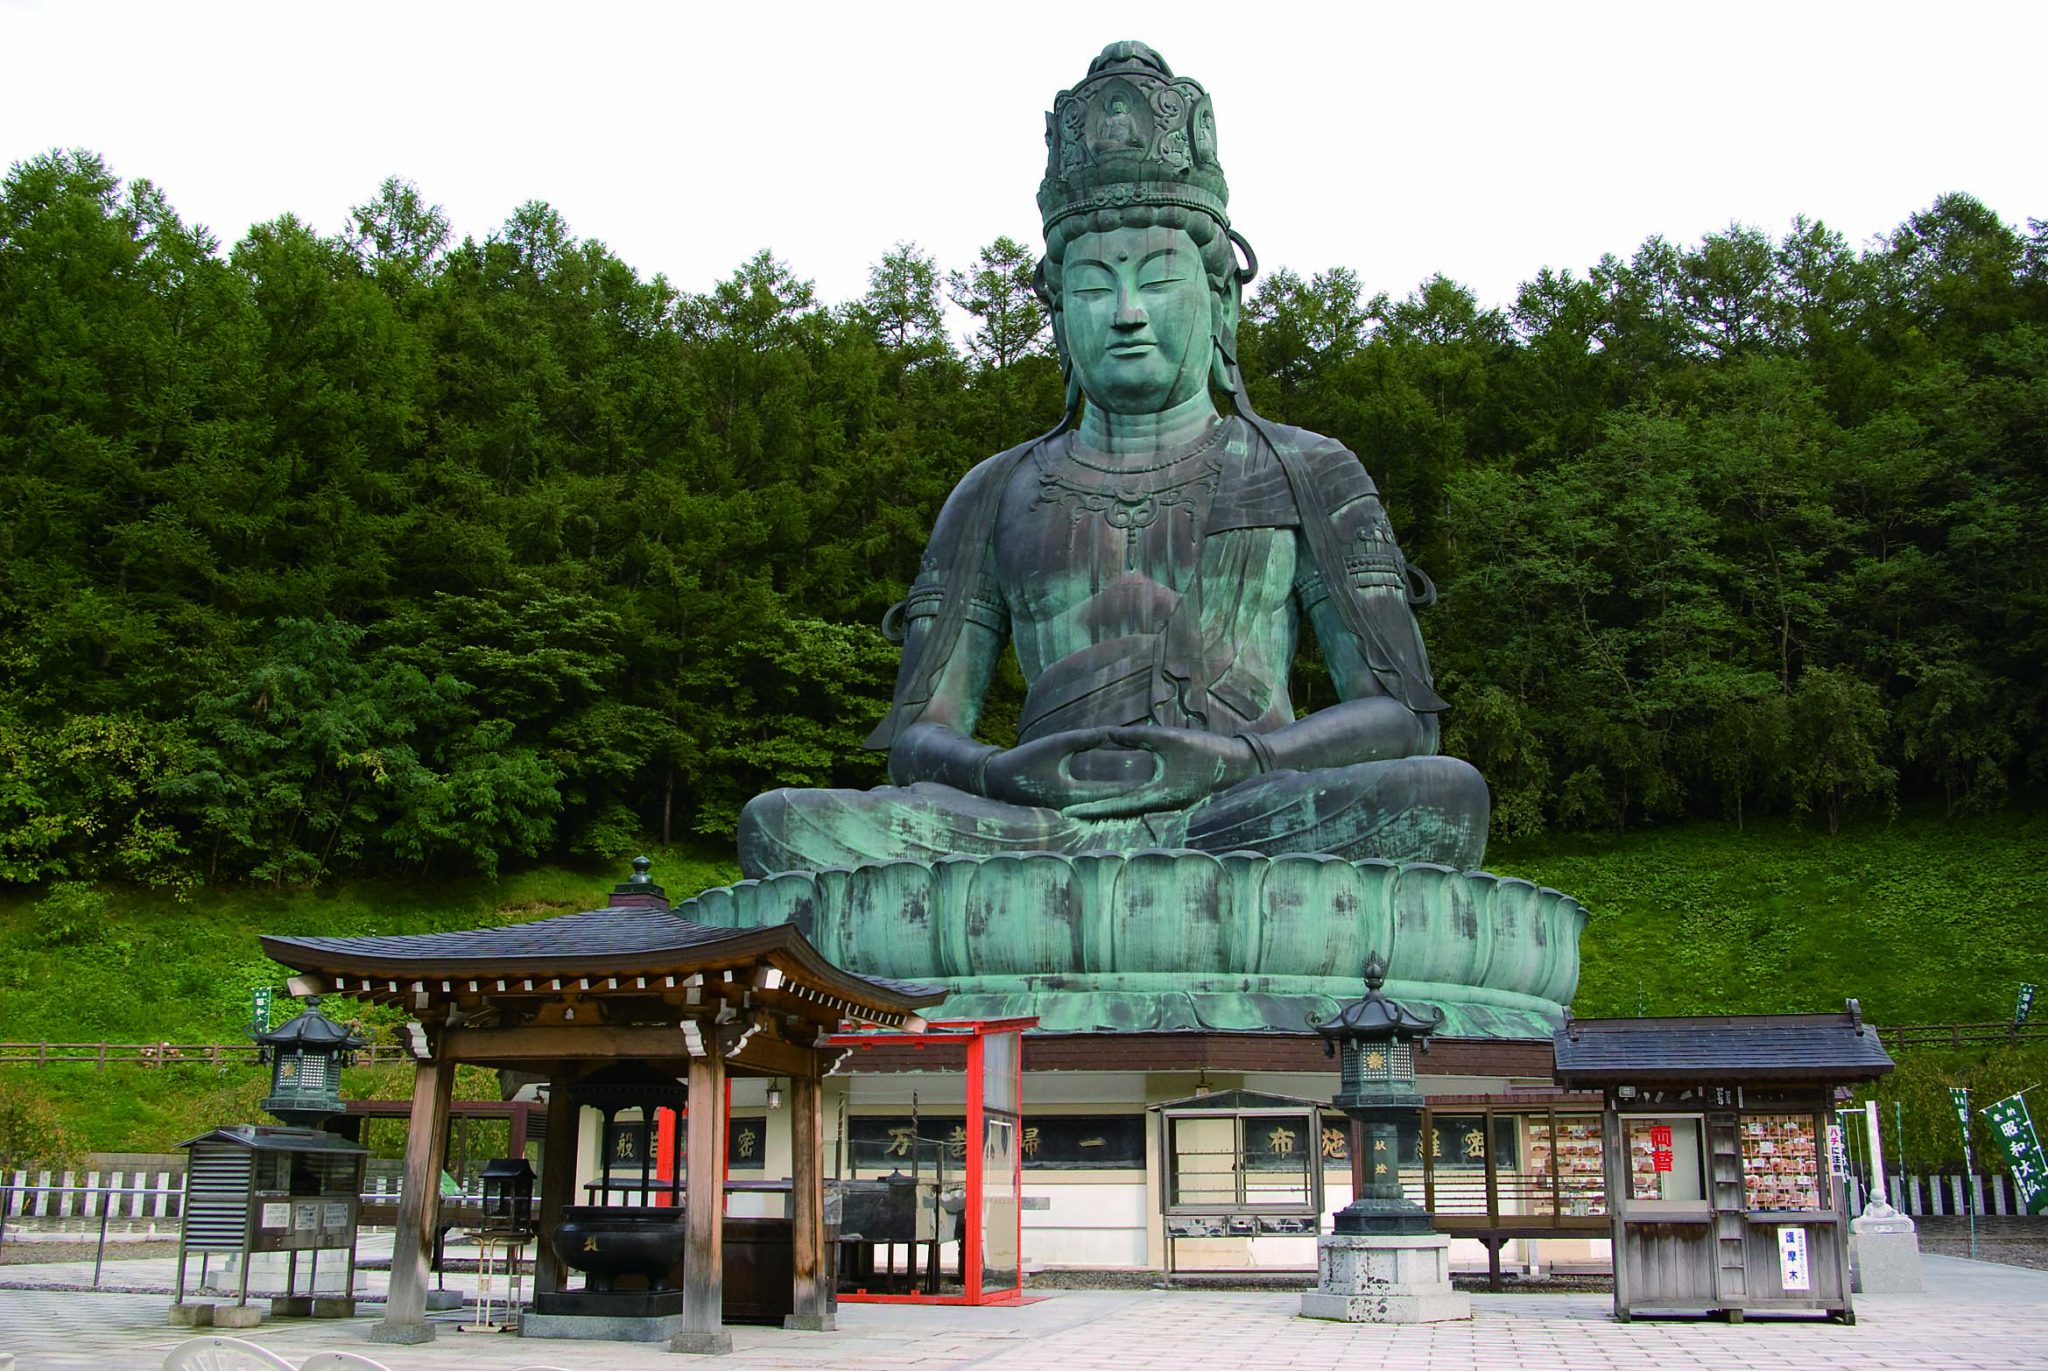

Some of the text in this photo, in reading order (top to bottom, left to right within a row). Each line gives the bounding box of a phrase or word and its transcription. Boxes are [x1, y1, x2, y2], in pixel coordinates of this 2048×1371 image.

[1649, 1126, 1673, 1173] 両替
[1830, 1128, 1842, 1173] ハチに注意
[2000, 1120, 2040, 1197] 昭和大仏
[1786, 1231, 1799, 1282] 護摩木
